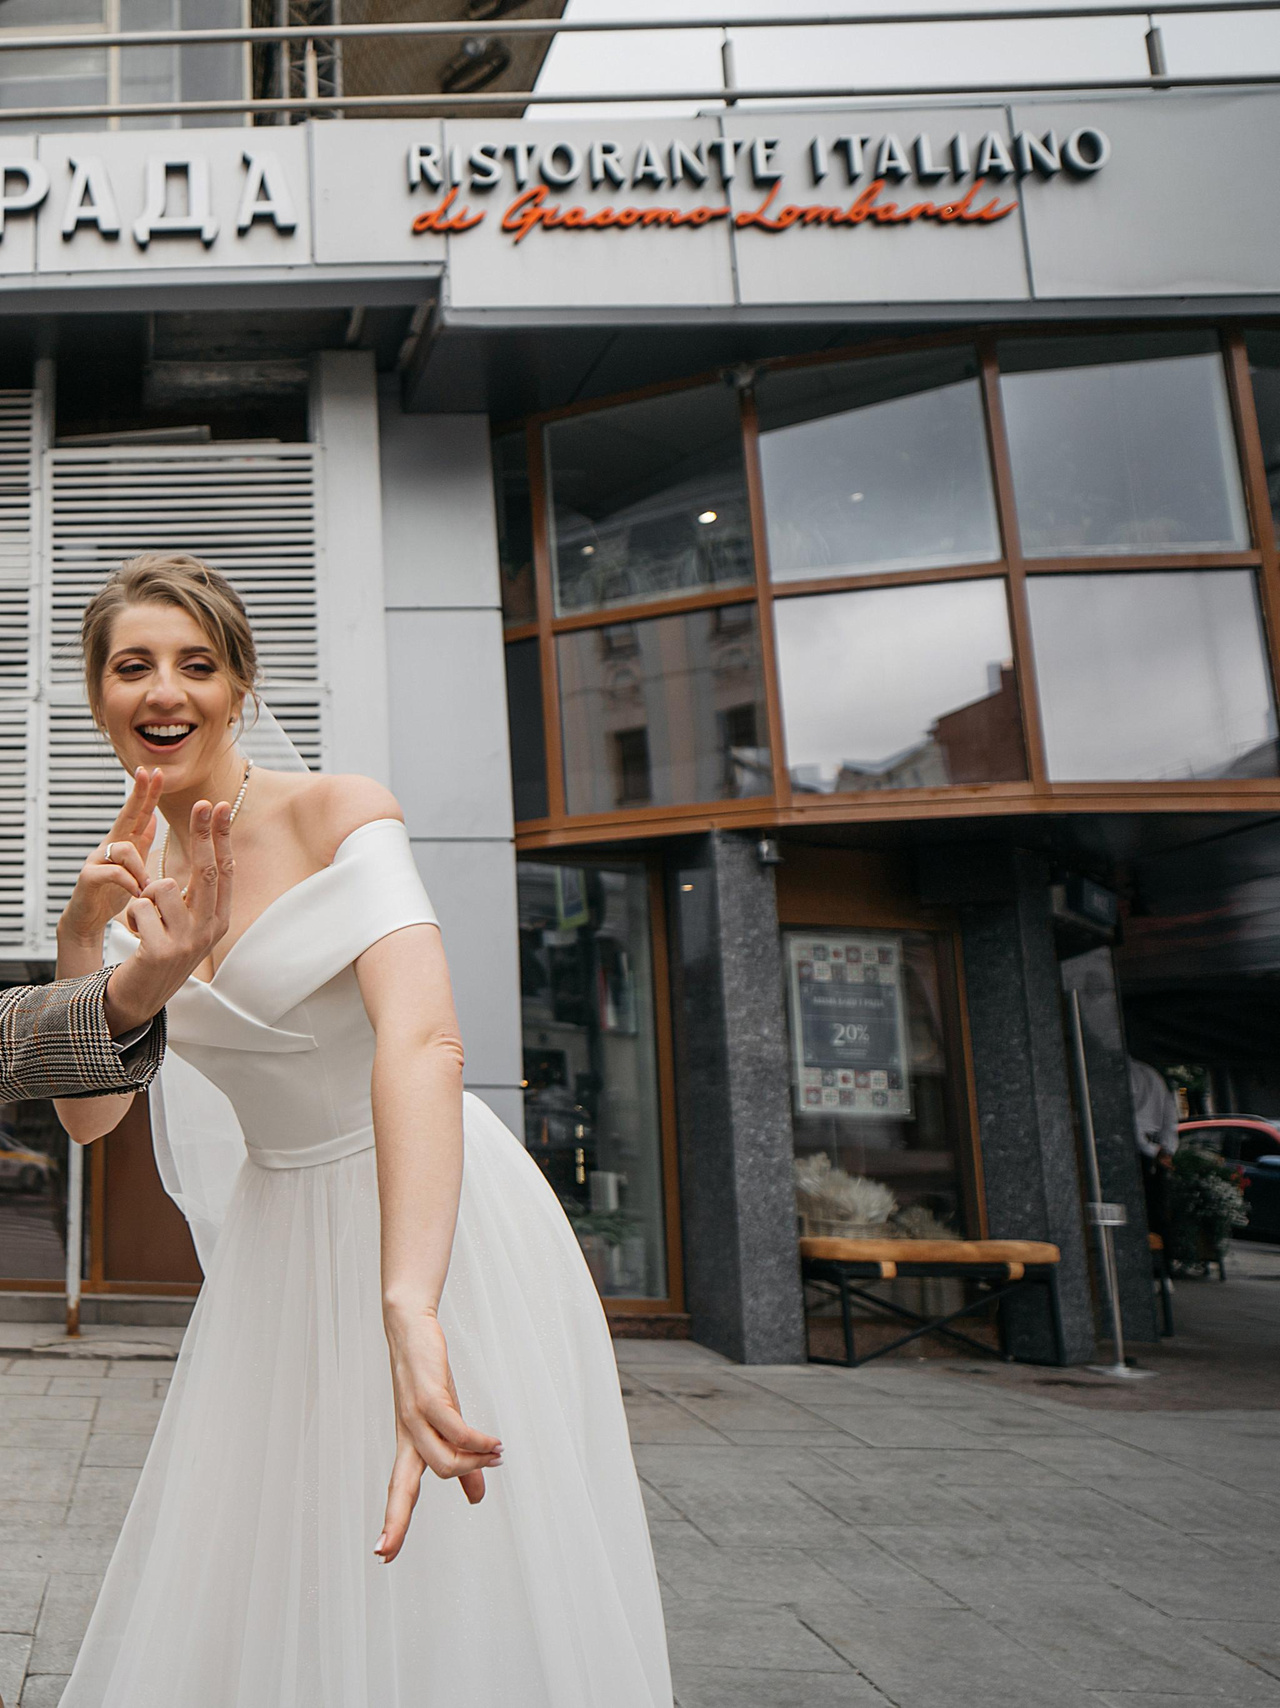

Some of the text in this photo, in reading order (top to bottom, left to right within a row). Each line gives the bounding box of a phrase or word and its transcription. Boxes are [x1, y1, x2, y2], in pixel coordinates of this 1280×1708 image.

[407, 126, 1112, 188] RISTORANTE ITALIANO
[412, 187, 487, 233] di
[735, 178, 1019, 232] Lombardi
[831, 1022, 870, 1046] 20%
